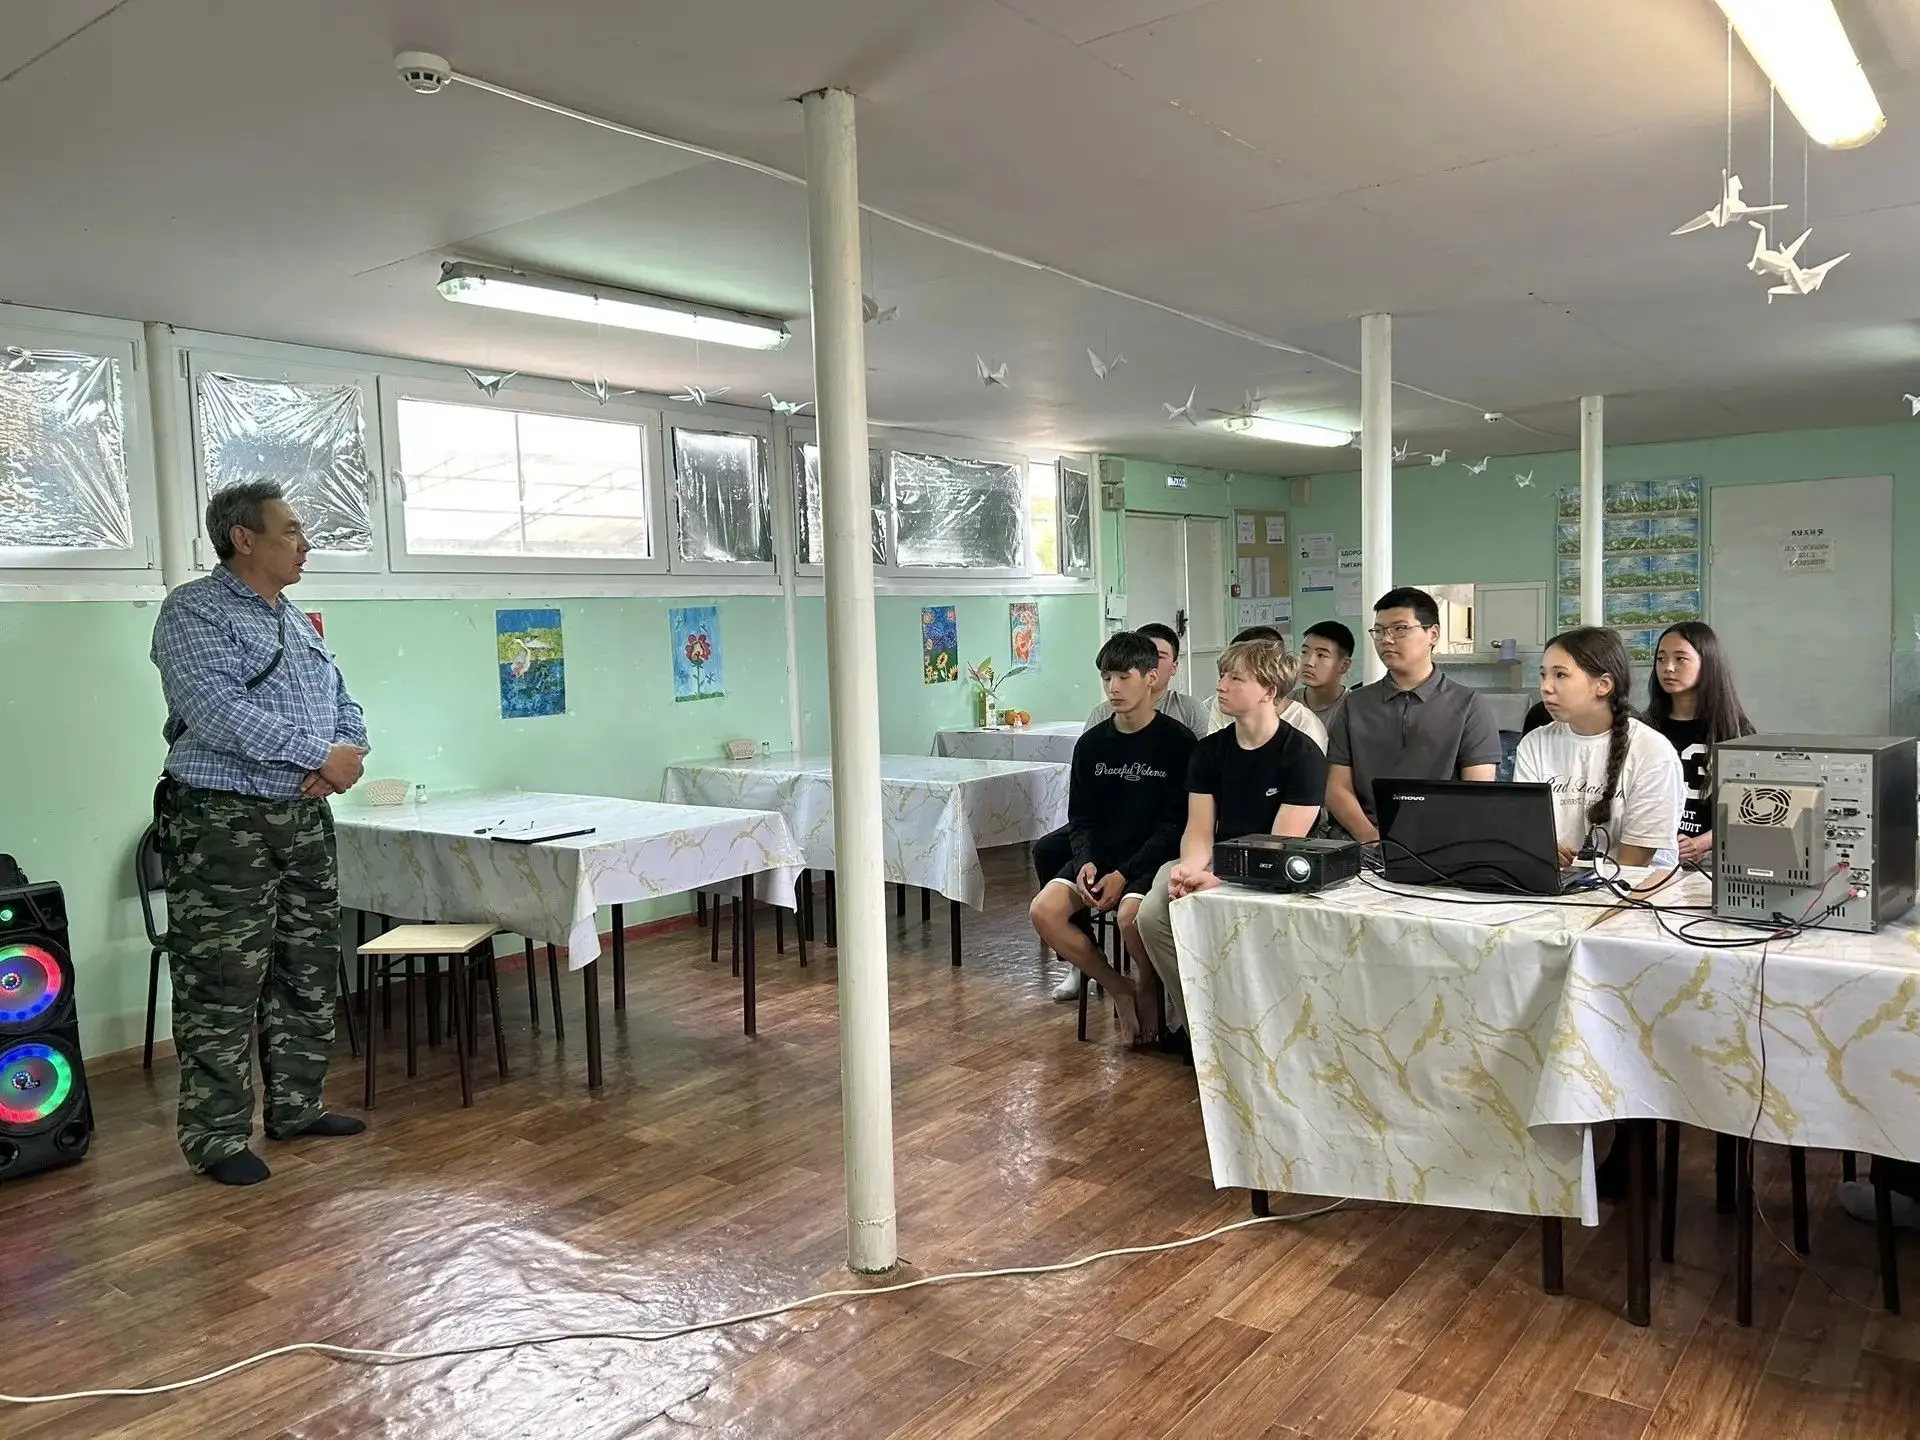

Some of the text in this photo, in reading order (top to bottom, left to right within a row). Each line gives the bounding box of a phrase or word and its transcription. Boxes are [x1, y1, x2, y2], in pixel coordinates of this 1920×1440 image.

[1791, 528, 1824, 536] КУХНЯ
[1340, 549, 1362, 557] ЗДОРО
[1682, 809, 1697, 820] UT
